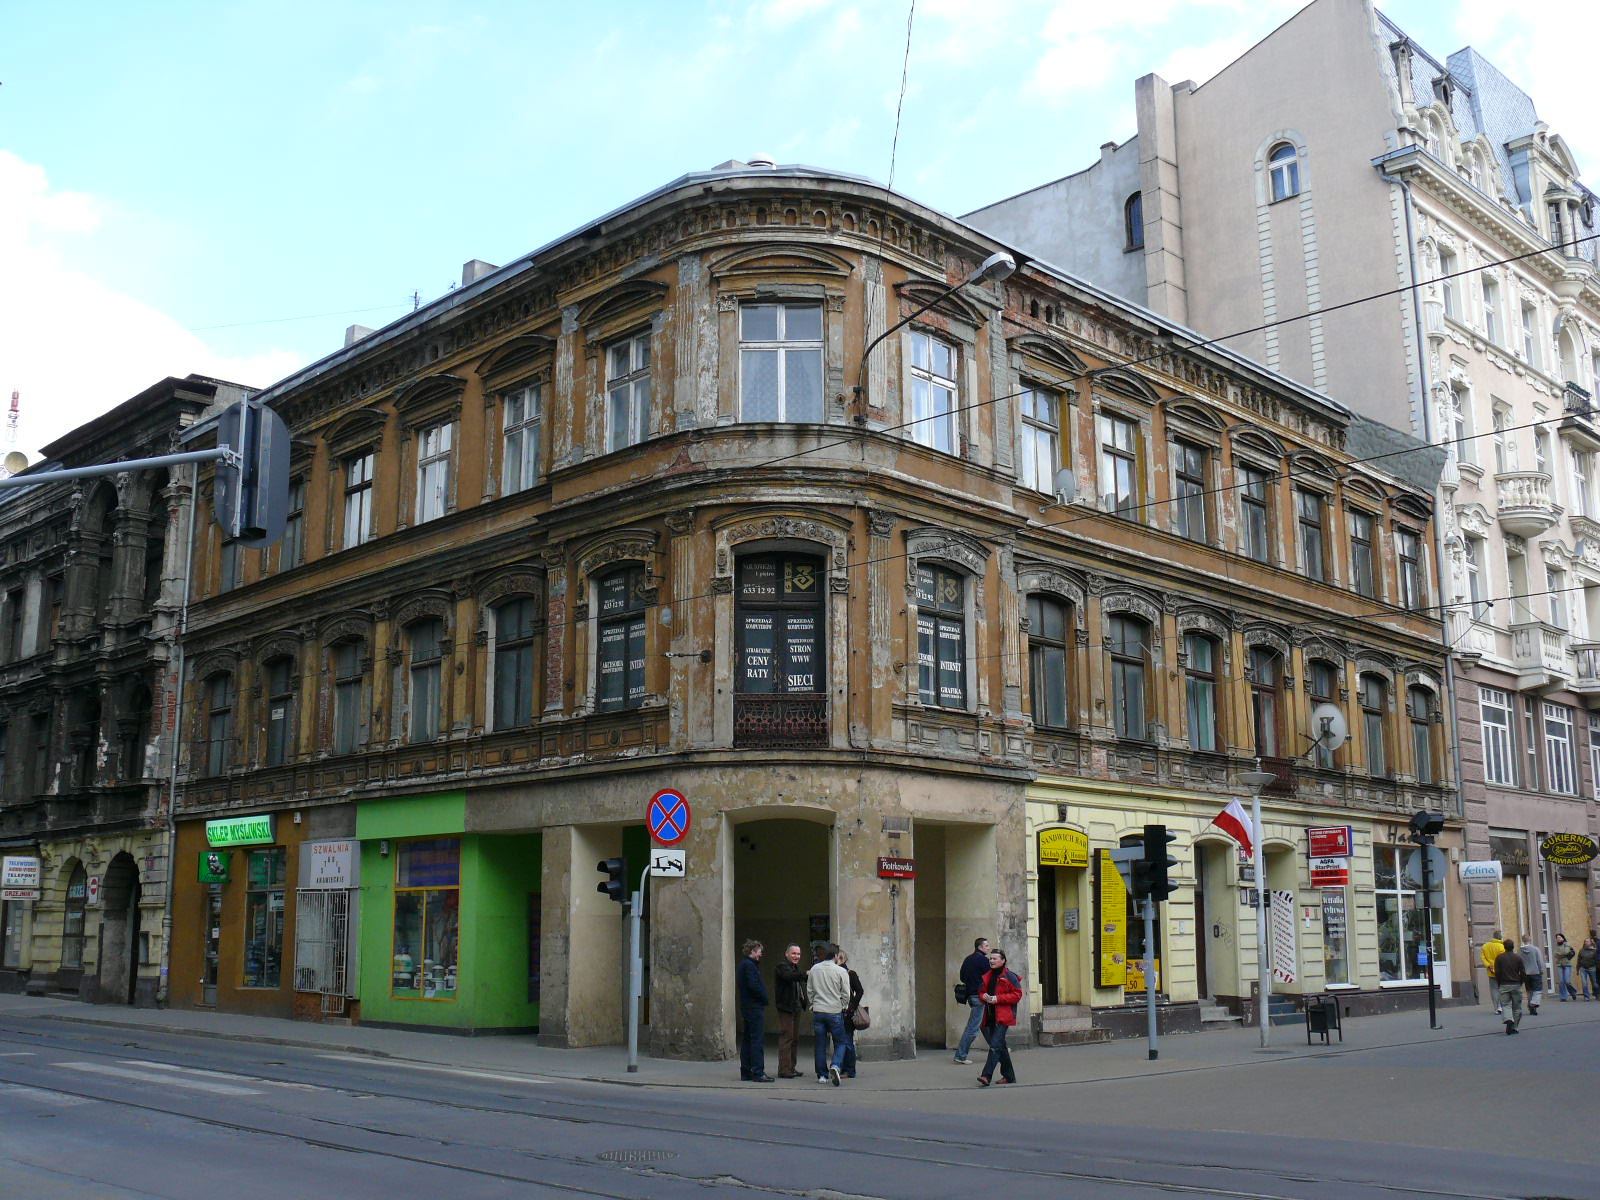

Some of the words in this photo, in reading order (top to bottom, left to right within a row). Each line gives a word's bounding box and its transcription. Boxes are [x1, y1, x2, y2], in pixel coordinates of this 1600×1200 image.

[789, 644, 812, 653] STRON
[747, 655, 769, 666] CENY
[791, 655, 811, 663] WWW
[940, 660, 962, 672] INTERNET
[747, 668, 769, 678] RATY
[787, 674, 814, 687] SIECI
[940, 686, 962, 696] GRAFIKA
[207, 825, 229, 842] SKLEP
[229, 821, 271, 841] MYŚLIWSKI
[1041, 833, 1074, 846] SANDWICH
[1075, 836, 1087, 849] BAR
[1542, 833, 1593, 850] CUKIERNIA
[313, 843, 349, 854] SZWALNIA
[1546, 854, 1591, 866] KAWIARNIA
[882, 861, 913, 871] Piotrkowska
[1463, 864, 1496, 876] felina
